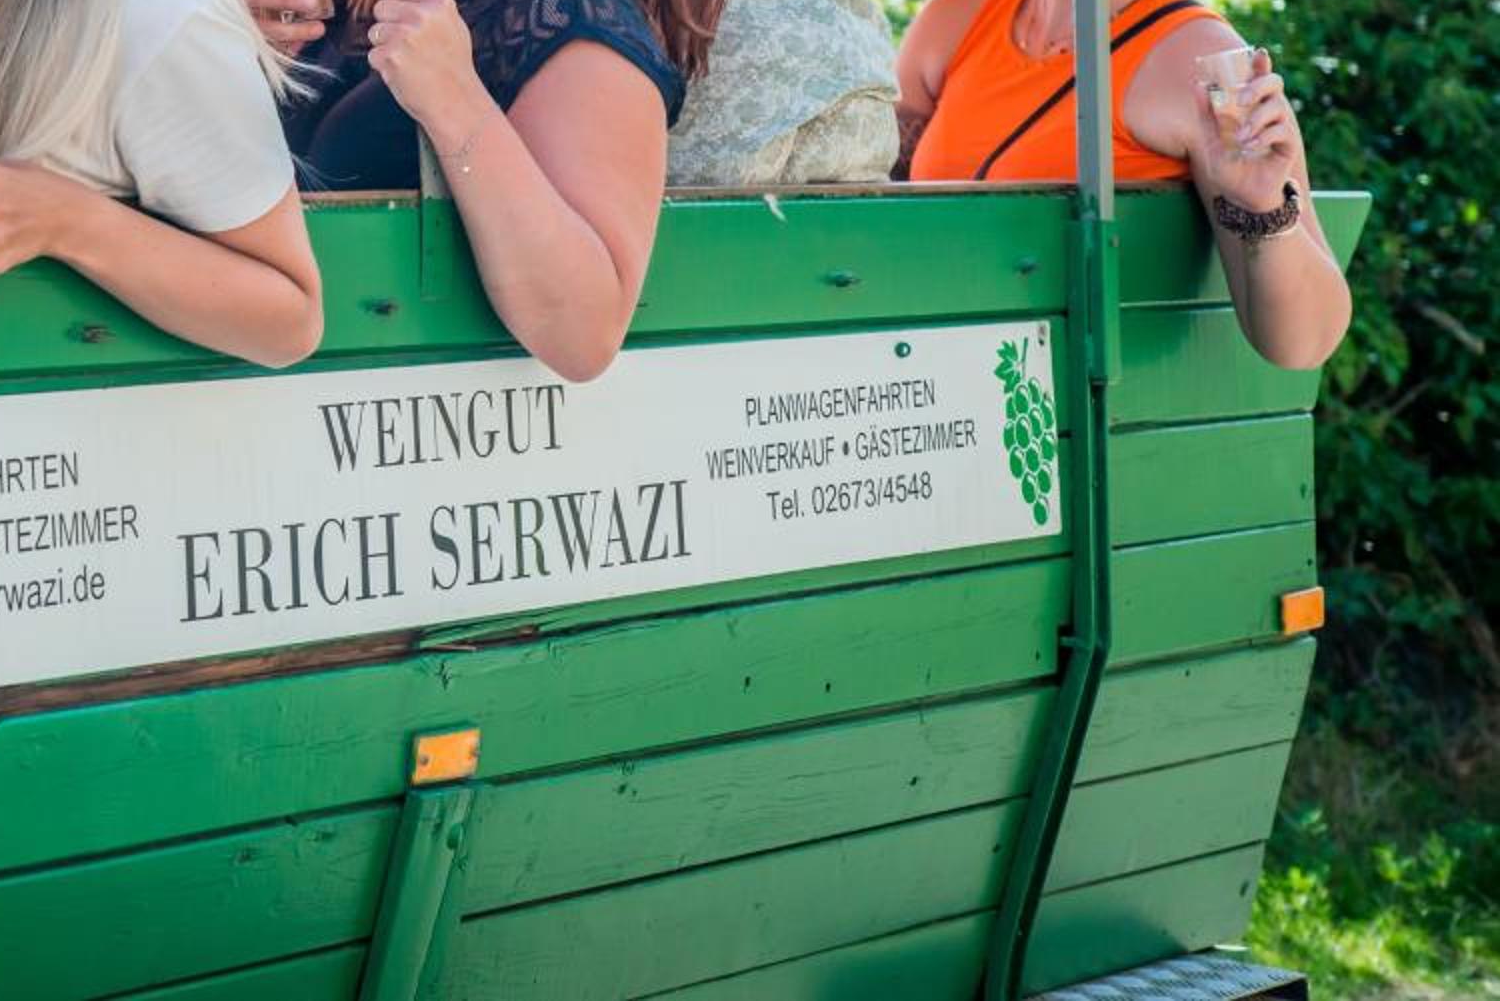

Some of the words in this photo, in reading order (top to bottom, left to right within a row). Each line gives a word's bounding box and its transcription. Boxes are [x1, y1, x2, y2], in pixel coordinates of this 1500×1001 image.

[317, 384, 565, 472] WEINGUT
[745, 379, 935, 426] PLANWAGENFAHRTEN
[706, 436, 835, 479] WEINVERKAUF
[855, 419, 977, 461] GÄSTEZIMMER
[766, 489, 805, 520] Tel.
[811, 470, 933, 515] 02673/4548
[177, 512, 405, 623] ERICH
[429, 479, 692, 591] SERWAZI
